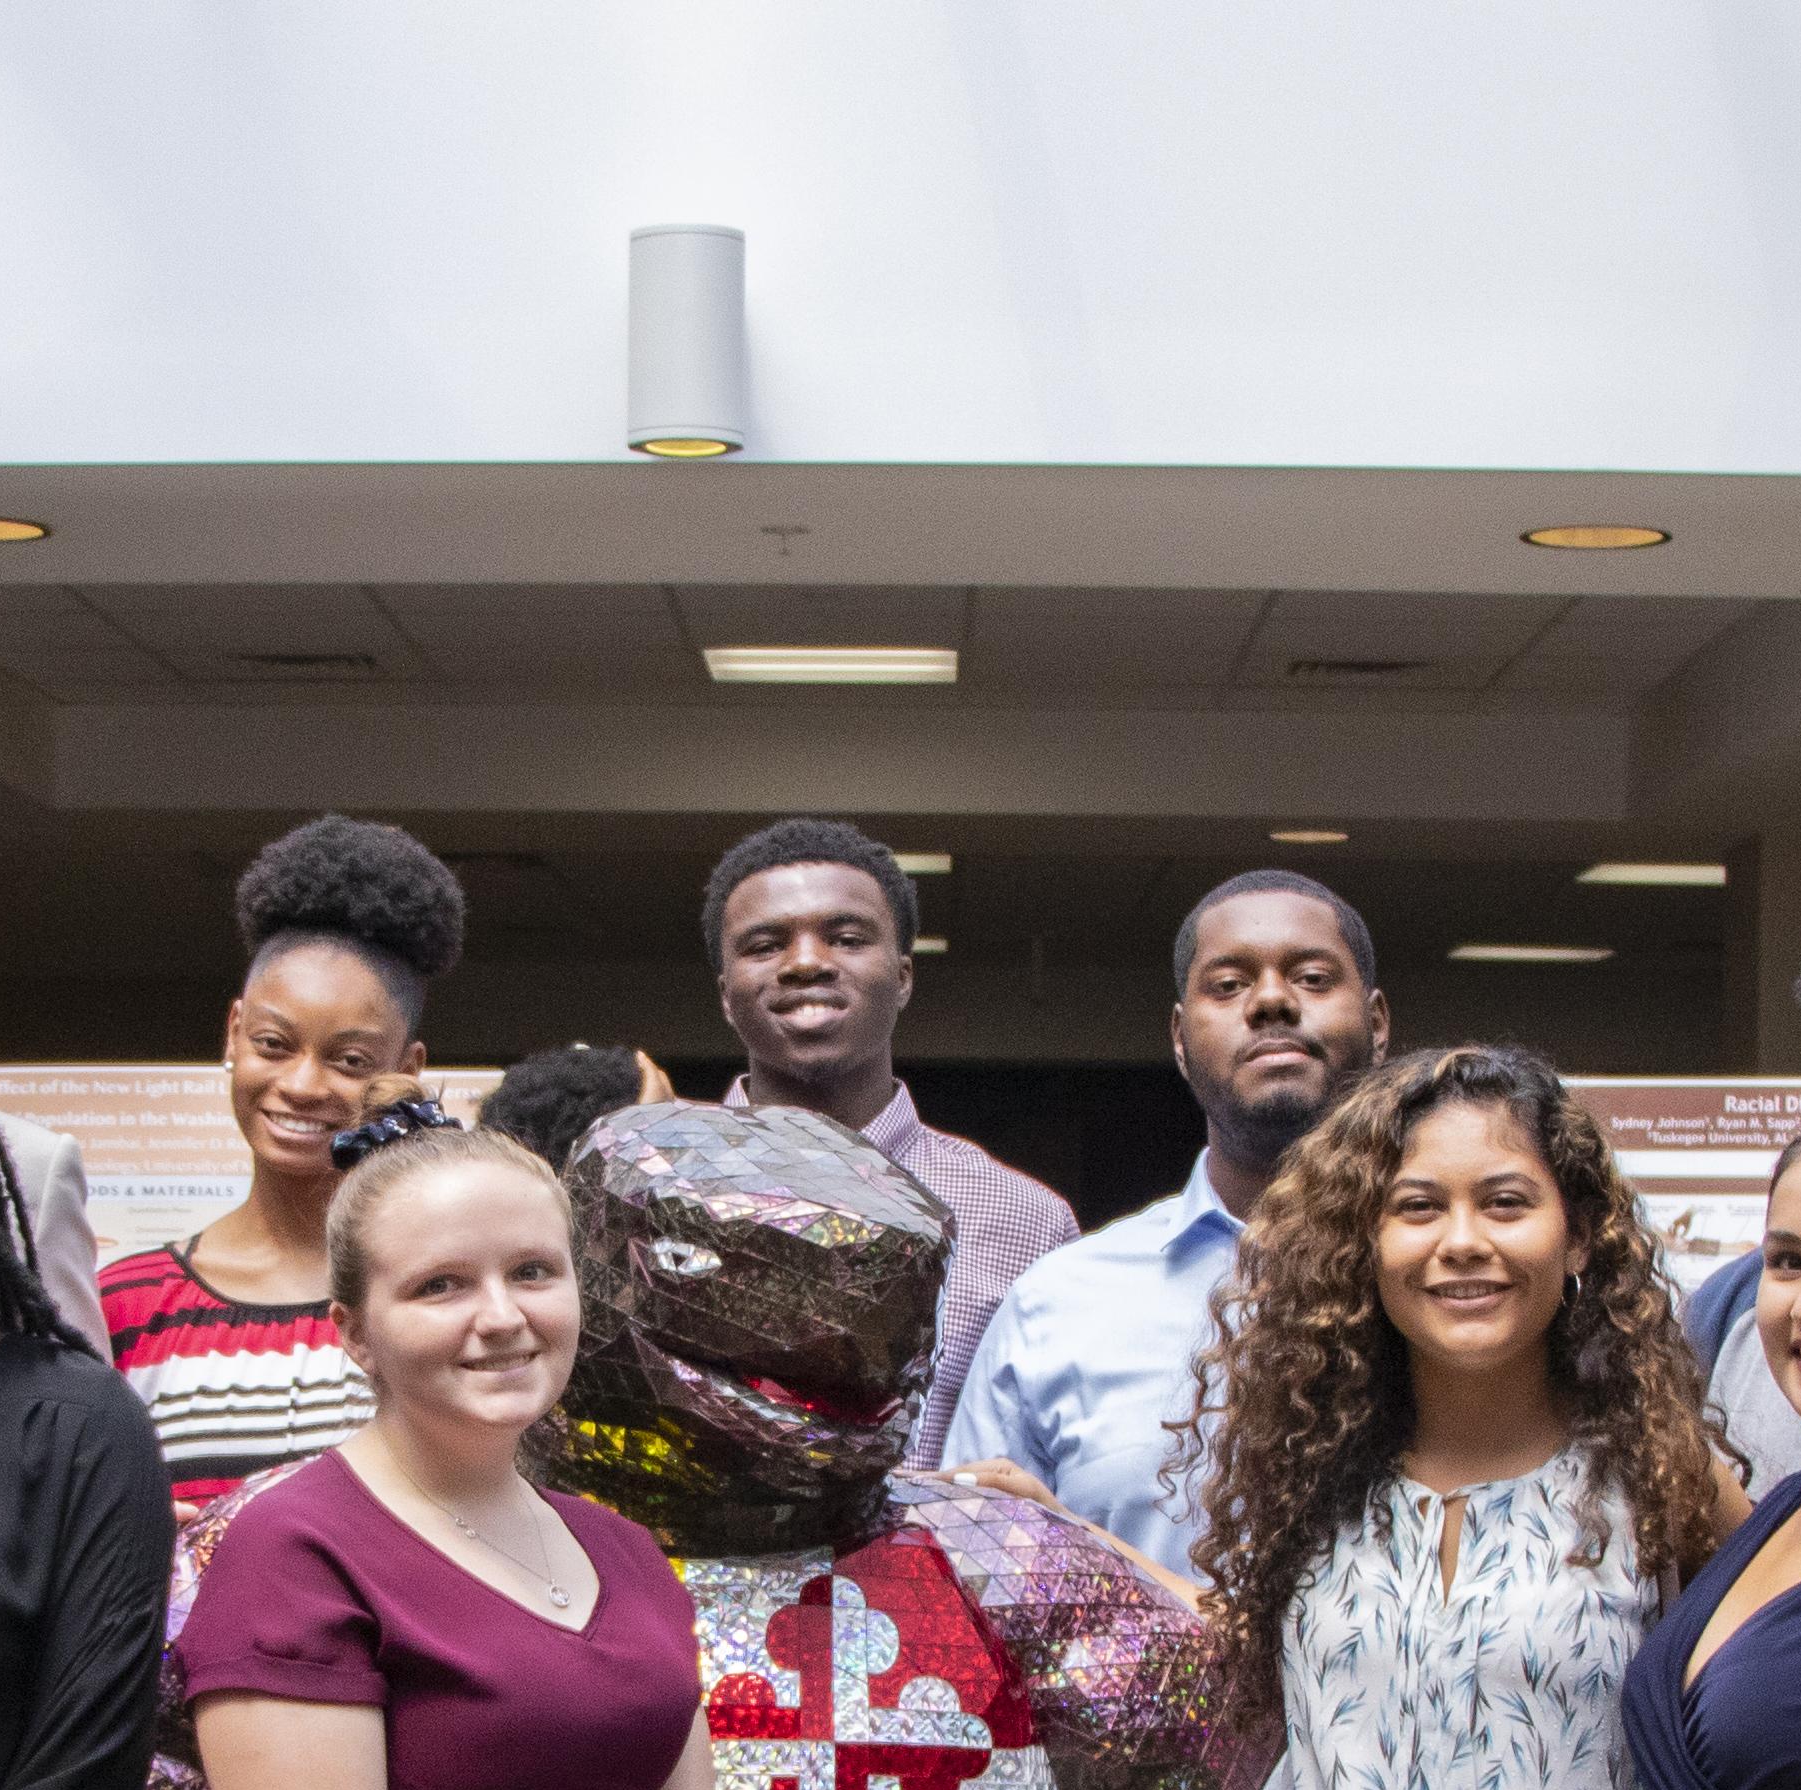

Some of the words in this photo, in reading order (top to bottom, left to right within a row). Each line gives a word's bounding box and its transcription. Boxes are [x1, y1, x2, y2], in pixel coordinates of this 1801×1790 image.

[38, 1078, 59, 1095] of
[61, 1079, 88, 1095] the
[92, 1080, 129, 1095] New
[135, 1080, 179, 1098] Light
[1725, 1095, 1781, 1113] Racial
[119, 1112, 137, 1126] in
[139, 1112, 169, 1126] the
[1611, 1116, 1654, 1131] Sydney
[1717, 1117, 1747, 1131] Ryan
[141, 1185, 235, 1197] MATERIALS
